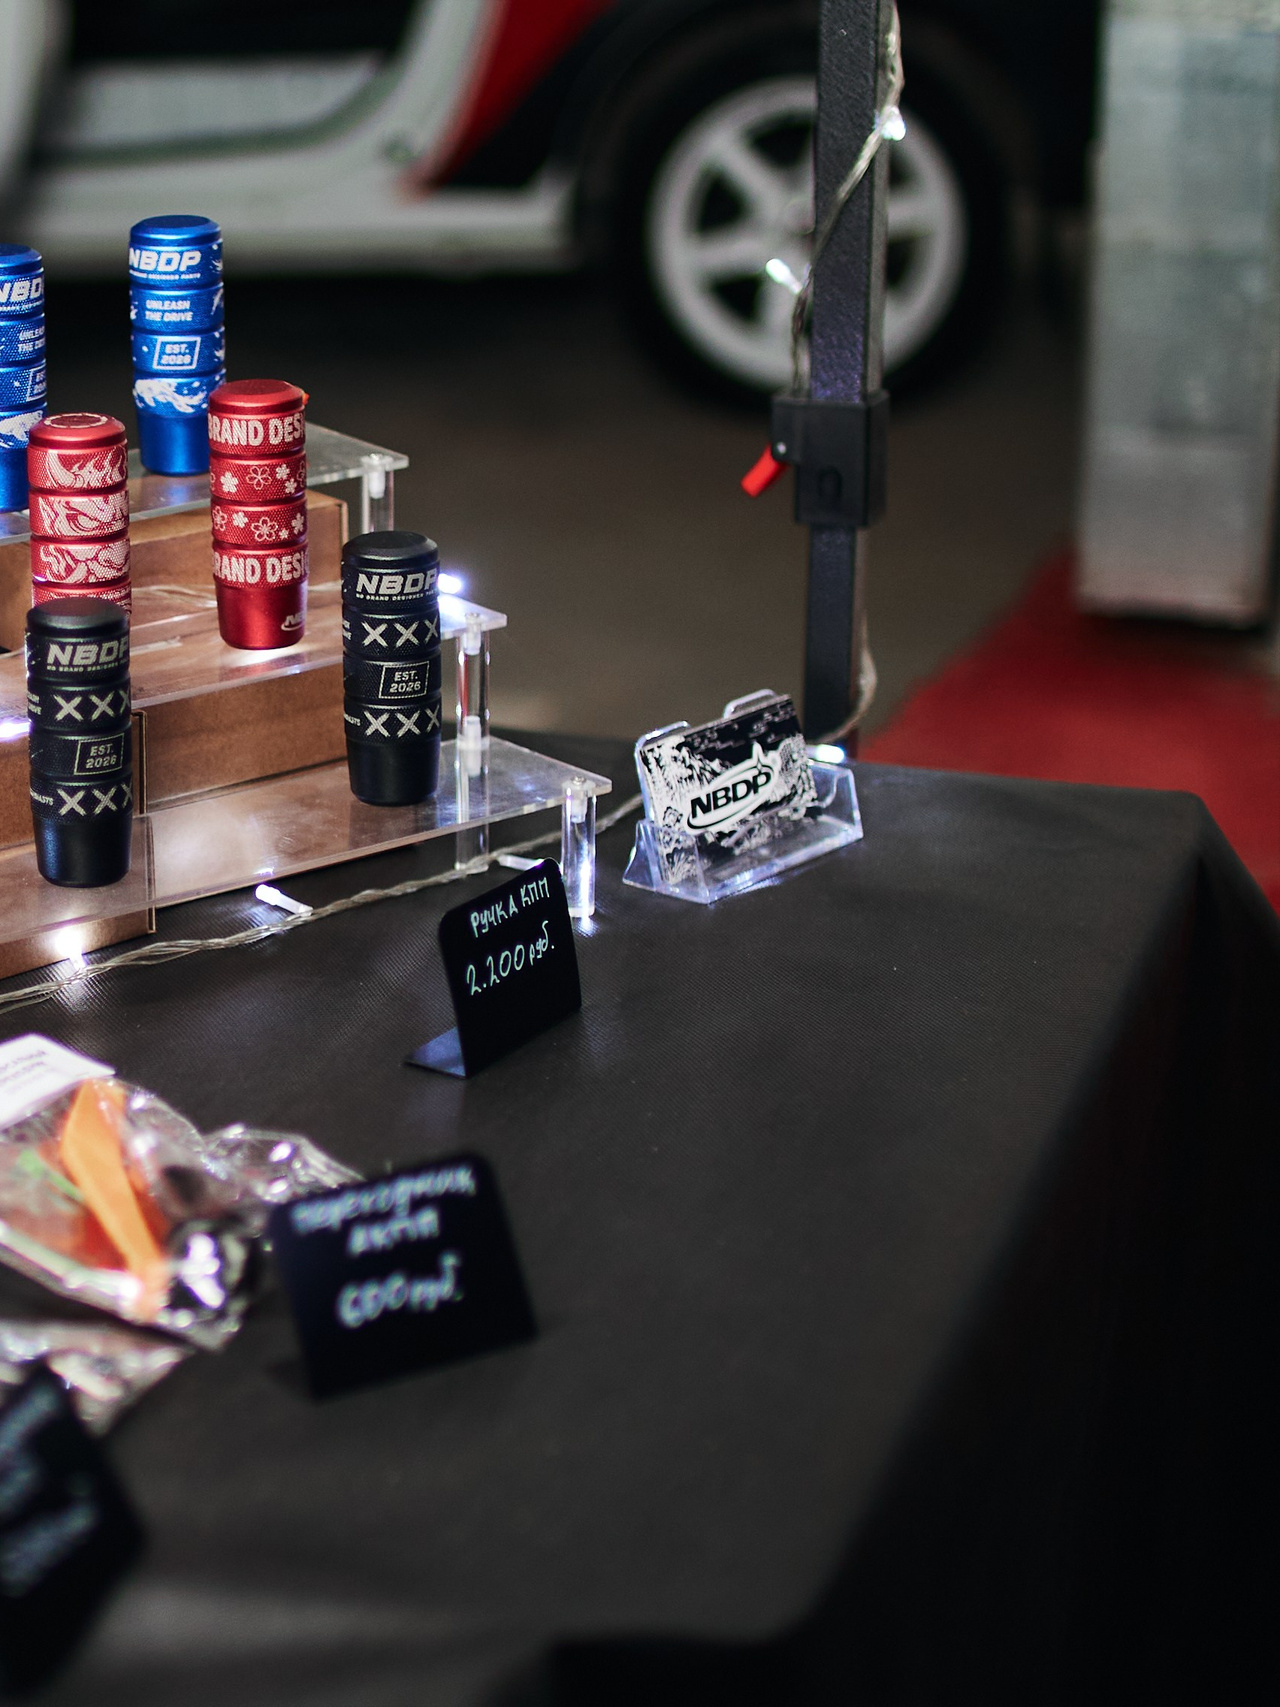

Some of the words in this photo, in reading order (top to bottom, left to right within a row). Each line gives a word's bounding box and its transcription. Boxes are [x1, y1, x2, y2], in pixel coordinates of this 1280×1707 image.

[129, 247, 202, 272] NBDP
[145, 299, 191, 311] UNLEASH
[144, 311, 162, 321] THE
[163, 311, 194, 322] DRIVE
[356, 568, 438, 595] NBDP
[394, 670, 419, 682] EST.
[389, 681, 422, 693] 2026
[90, 743, 114, 757] EST.
[85, 754, 118, 769] 2026
[689, 771, 772, 819] NBDP
